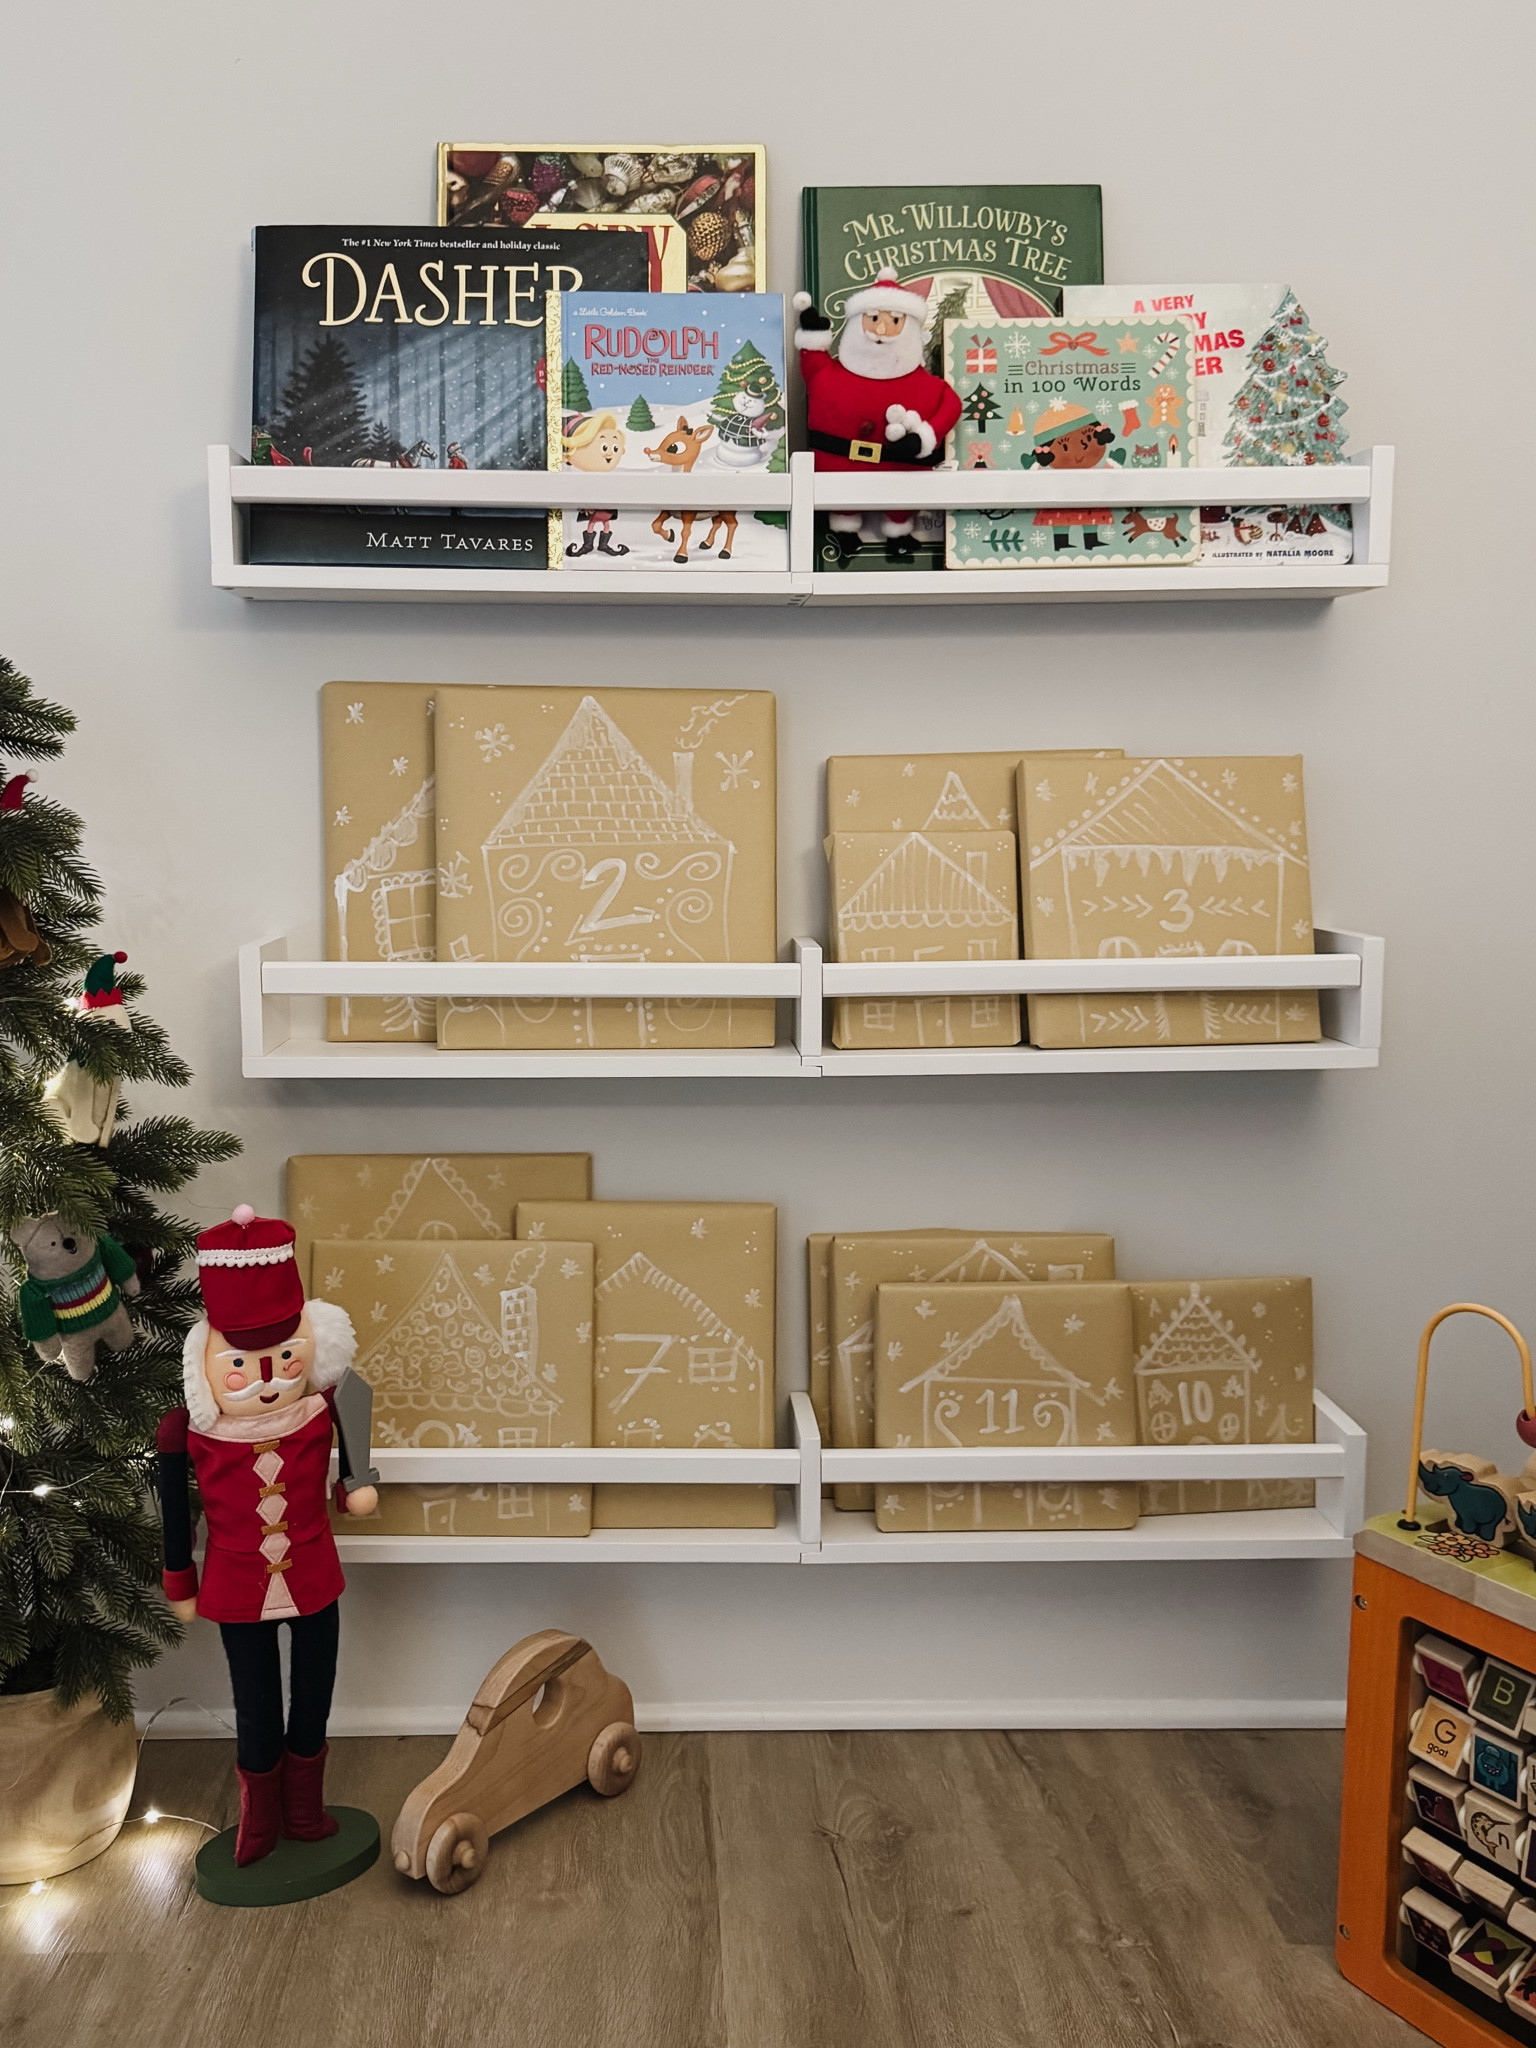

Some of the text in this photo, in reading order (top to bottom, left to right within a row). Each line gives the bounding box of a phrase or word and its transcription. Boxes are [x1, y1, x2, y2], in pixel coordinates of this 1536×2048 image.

[843, 202, 1068, 247] MR. WILLOWBY'S
[342, 237, 561, 252] The #1 New York Times bestseller and holiday classic
[844, 237, 1073, 281] CHRISTMAS TREE
[579, 307, 599, 317] Little
[600, 307, 626, 317] Golden
[626, 307, 647, 317] Book
[1133, 294, 1194, 314] A VERY
[584, 323, 719, 360] RUDOLPH
[591, 362, 714, 377] RED-NOSED REINDEER
[1025, 360, 1120, 376] Christmas
[1004, 375, 1141, 394] in 100 Words
[366, 532, 534, 552] MATT TAVARES
[1303, 549, 1334, 557] MOORE
[565, 858, 659, 946] 2
[1159, 888, 1195, 932] 3
[609, 1333, 679, 1414] 7
[976, 1388, 1026, 1434] 11
[1178, 1380, 1215, 1425] 10
[1492, 1676, 1516, 1705] B
[1434, 1718, 1457, 1744] G
[1425, 1743, 1449, 1758] goat
